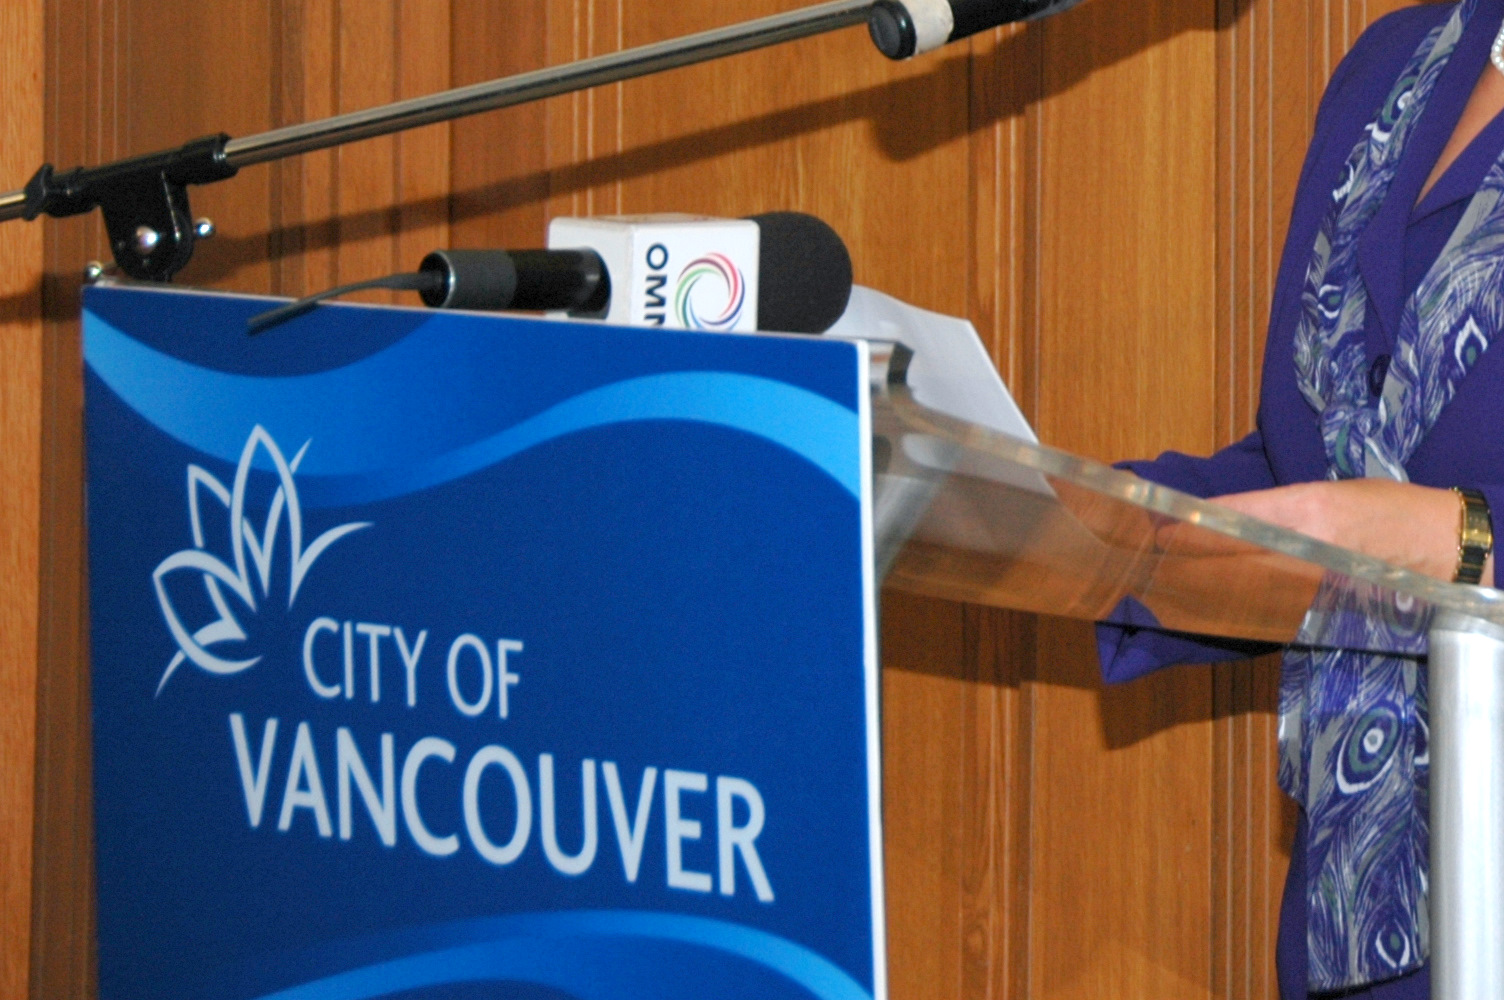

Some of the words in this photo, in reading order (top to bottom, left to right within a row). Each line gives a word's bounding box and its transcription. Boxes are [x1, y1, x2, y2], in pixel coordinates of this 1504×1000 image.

[302, 616, 427, 707] CITY
[446, 632, 525, 720] OF
[228, 712, 776, 903] VANCOUVER
